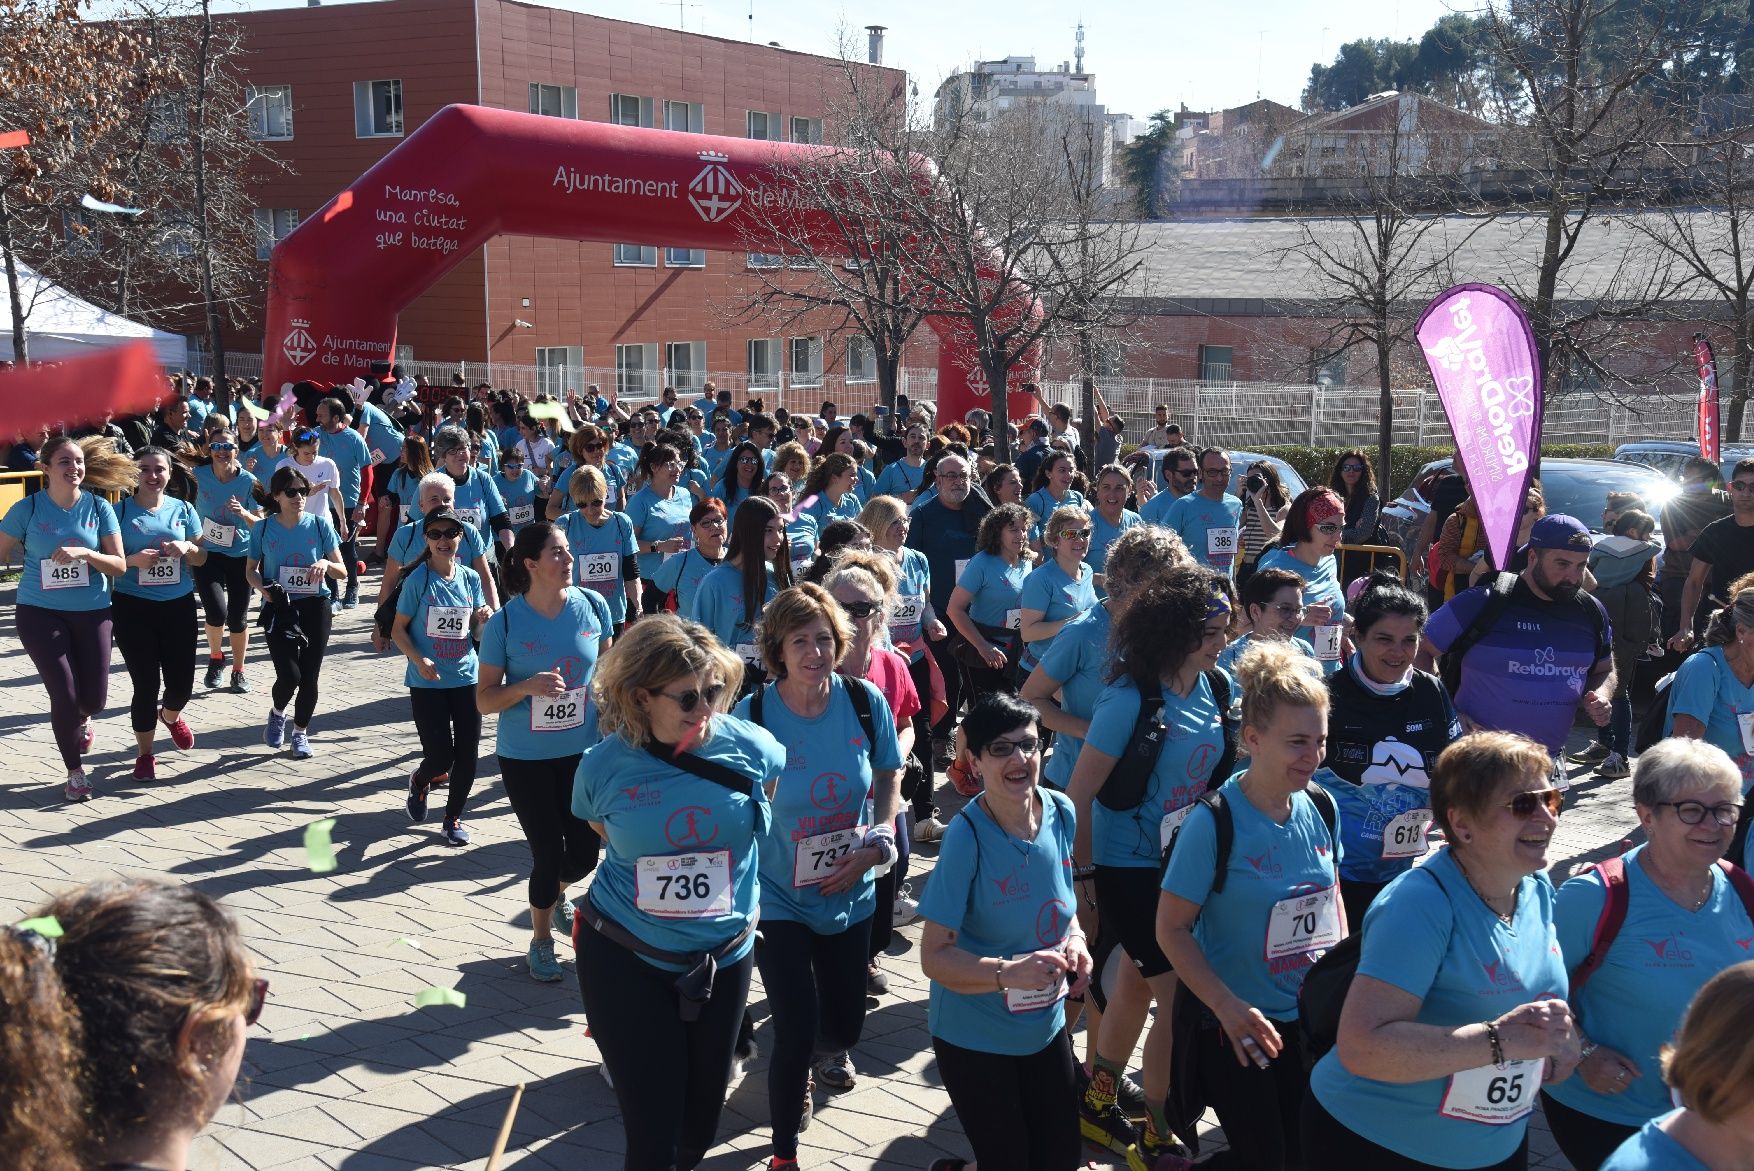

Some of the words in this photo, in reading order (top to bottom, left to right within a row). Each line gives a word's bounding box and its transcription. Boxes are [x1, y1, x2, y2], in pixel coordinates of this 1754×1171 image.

[552, 165, 679, 199] Ajuntament
[385, 184, 460, 208] Manresa,
[376, 208, 407, 224] una
[414, 209, 468, 230] ciutat
[376, 231, 403, 249] que
[411, 231, 458, 254] batega
[322, 334, 391, 353] Ajuntament
[321, 352, 340, 366] de
[209, 528, 223, 540] 53
[1215, 537, 1232, 547] 385
[52, 566, 80, 580] 485
[148, 565, 174, 577] 483
[588, 562, 612, 575] 230
[287, 575, 312, 587] 484
[893, 605, 916, 618] 229
[437, 617, 463, 631] 245
[543, 702, 577, 720] 482
[1394, 824, 1420, 845] 613
[811, 843, 850, 871] 737
[656, 872, 711, 901] 736
[1292, 911, 1316, 938] 70
[1487, 1073, 1524, 1105] 65
